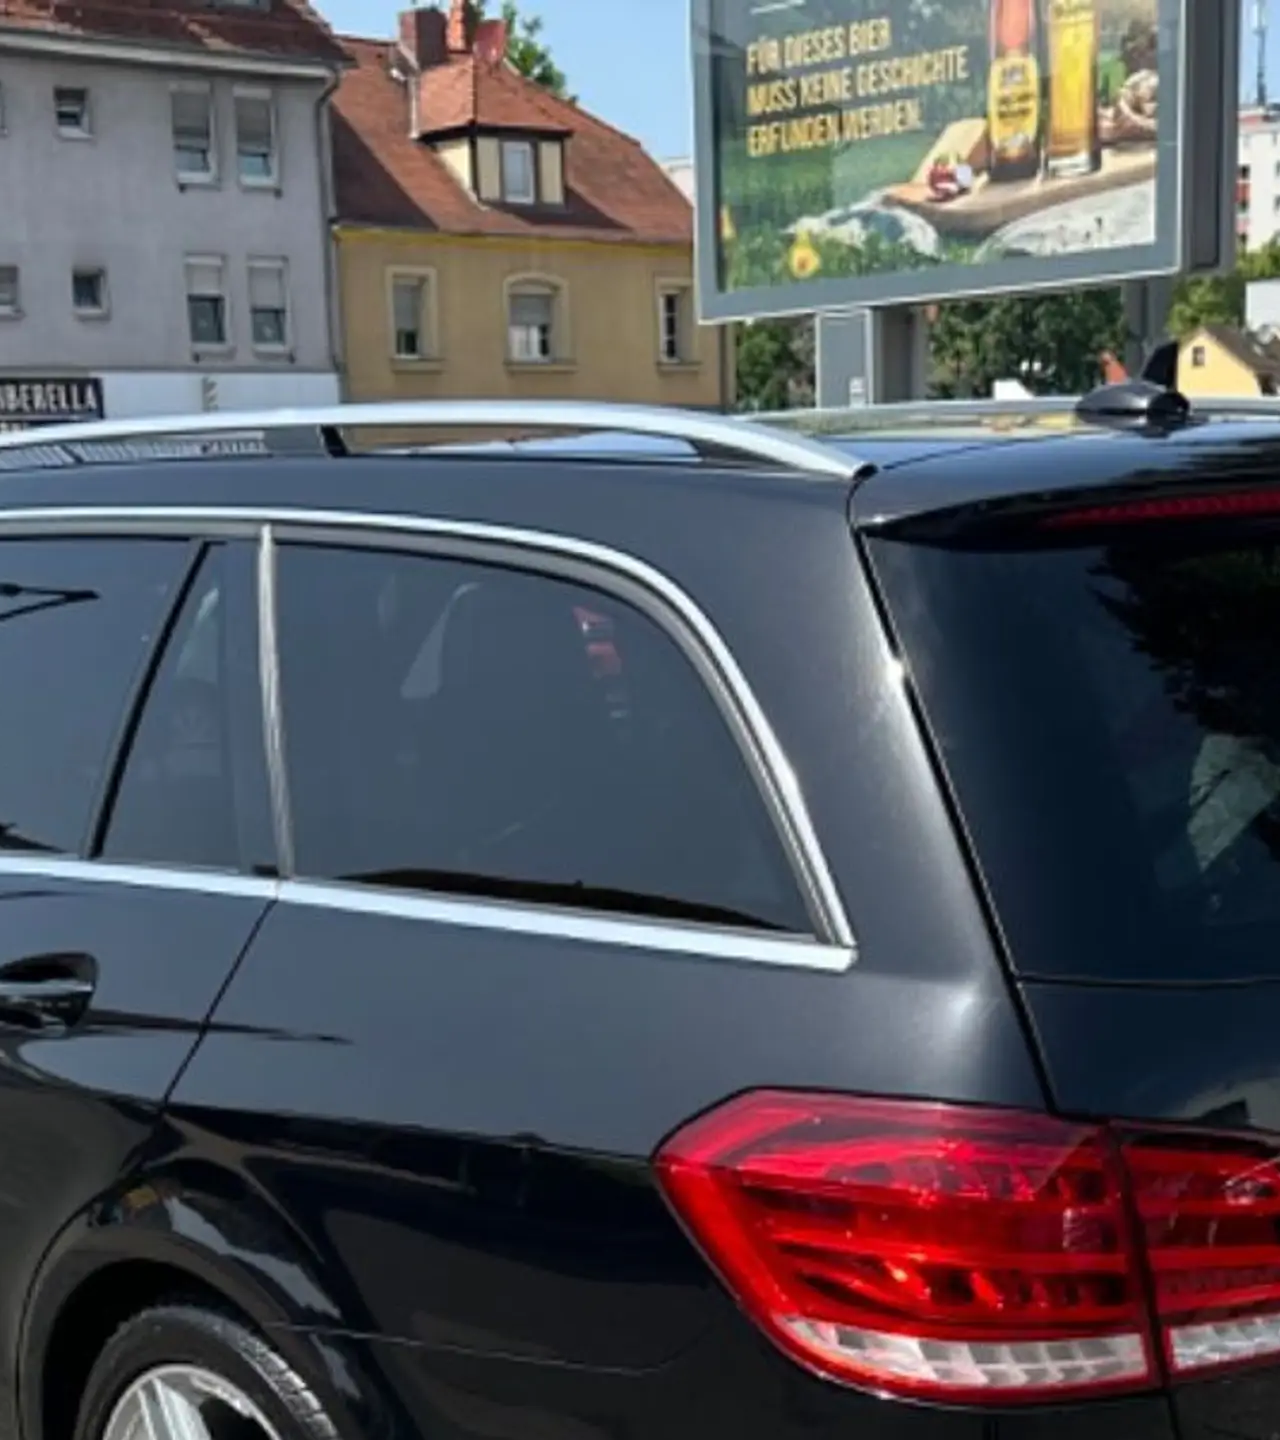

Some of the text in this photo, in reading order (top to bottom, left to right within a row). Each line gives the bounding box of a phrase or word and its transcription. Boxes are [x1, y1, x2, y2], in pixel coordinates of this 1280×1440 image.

[747, 17, 892, 76] FÜR DIESES BIER
[747, 45, 968, 116] MUSS KEINE GESCHICHTE
[747, 112, 840, 158] ERFUNDEN
